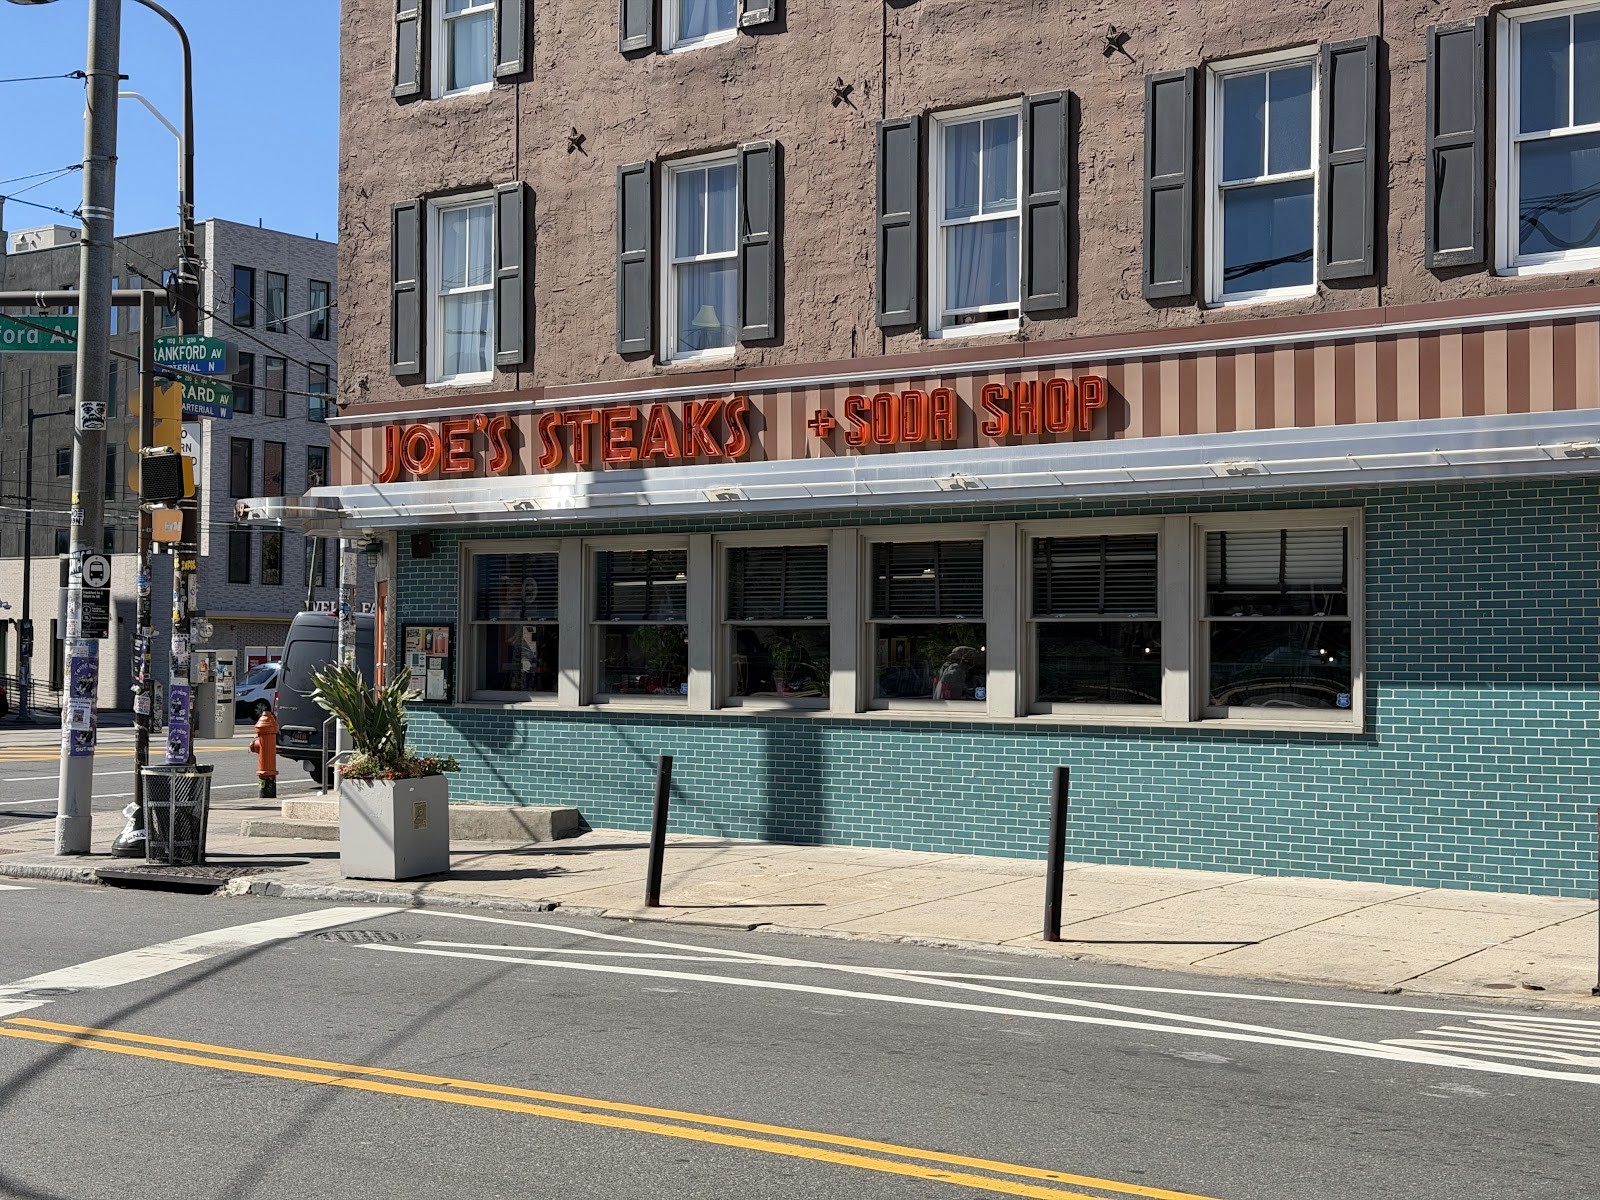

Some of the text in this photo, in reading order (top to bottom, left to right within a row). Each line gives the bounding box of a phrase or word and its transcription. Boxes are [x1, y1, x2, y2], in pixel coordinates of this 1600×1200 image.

[153, 344, 223, 362] RANKFORD AV
[208, 361, 215, 372] N
[181, 384, 230, 405] RARD AV
[181, 403, 227, 418] ARTERIAL W
[379, 413, 513, 484] JOE'S
[537, 396, 751, 471] STEAKS
[843, 387, 959, 447] SODA
[980, 374, 1109, 438] SHOP
[304, 600, 336, 612] WEL
